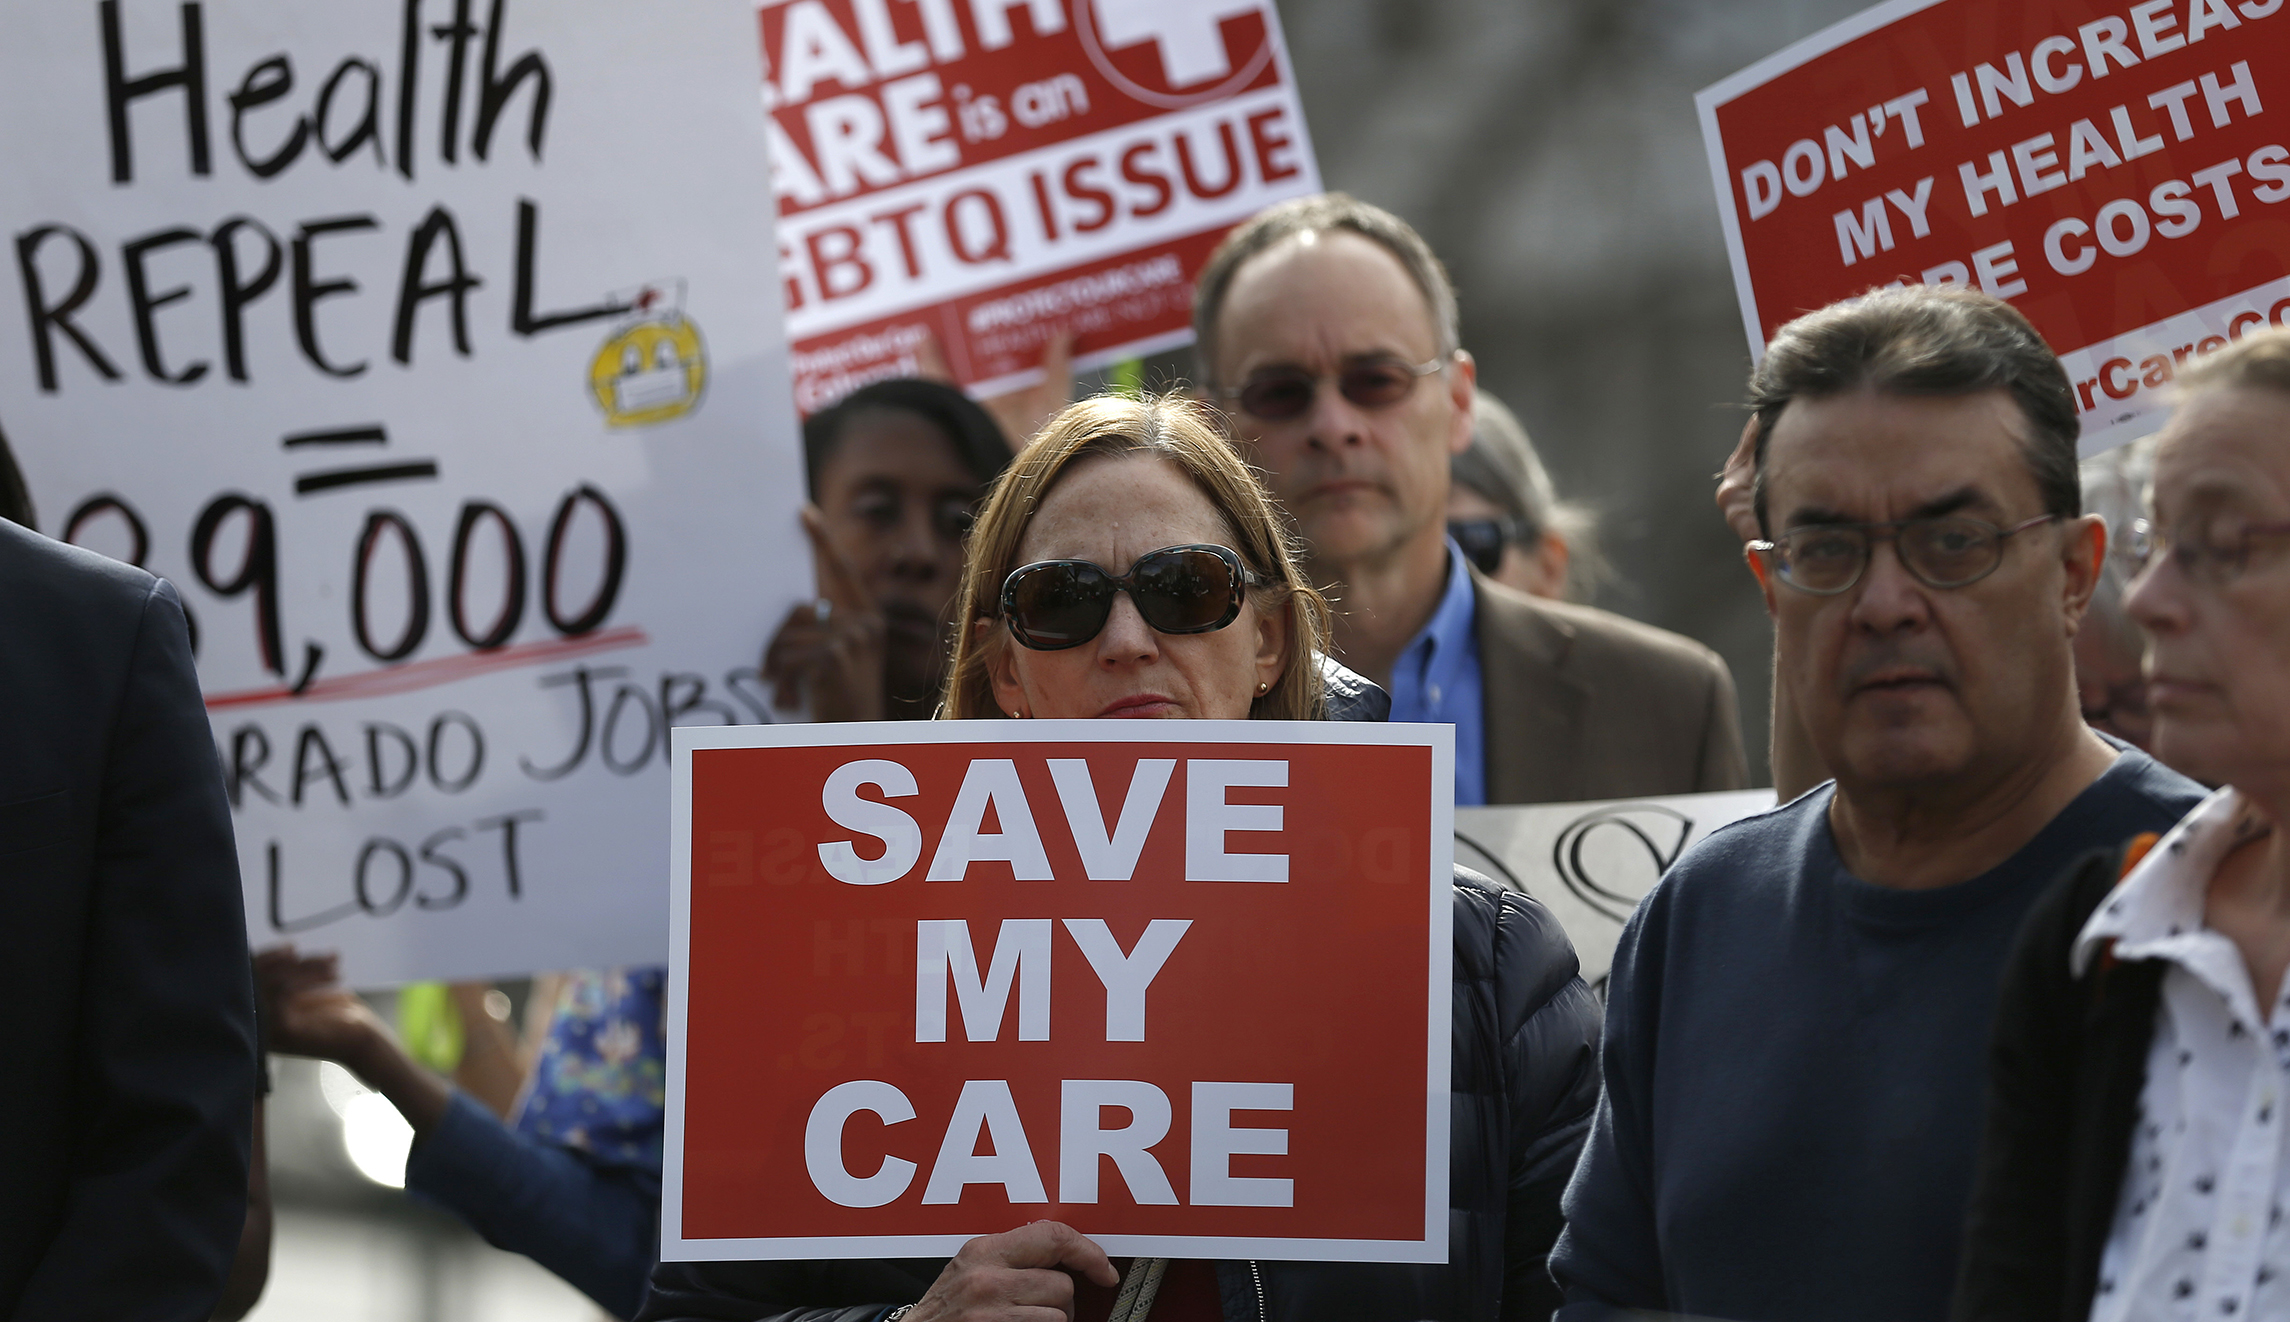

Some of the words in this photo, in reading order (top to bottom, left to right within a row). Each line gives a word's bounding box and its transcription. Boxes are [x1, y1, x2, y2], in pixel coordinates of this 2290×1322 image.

[103, 0, 553, 184] Health
[767, 71, 962, 200] ARE
[950, 82, 1008, 145] is
[1011, 71, 1091, 130] an
[1029, 106, 1304, 244] ISSUE
[1832, 176, 1935, 266] MY
[1957, 59, 2265, 218] HEALTH
[2043, 143, 2290, 277] COSTS
[15, 199, 633, 394] REPEAL
[214, 708, 488, 812] RADO
[817, 757, 1290, 887] SAVE
[266, 809, 546, 934] LOST
[915, 918, 1194, 1043] MY
[803, 1078, 1295, 1209] CARE
